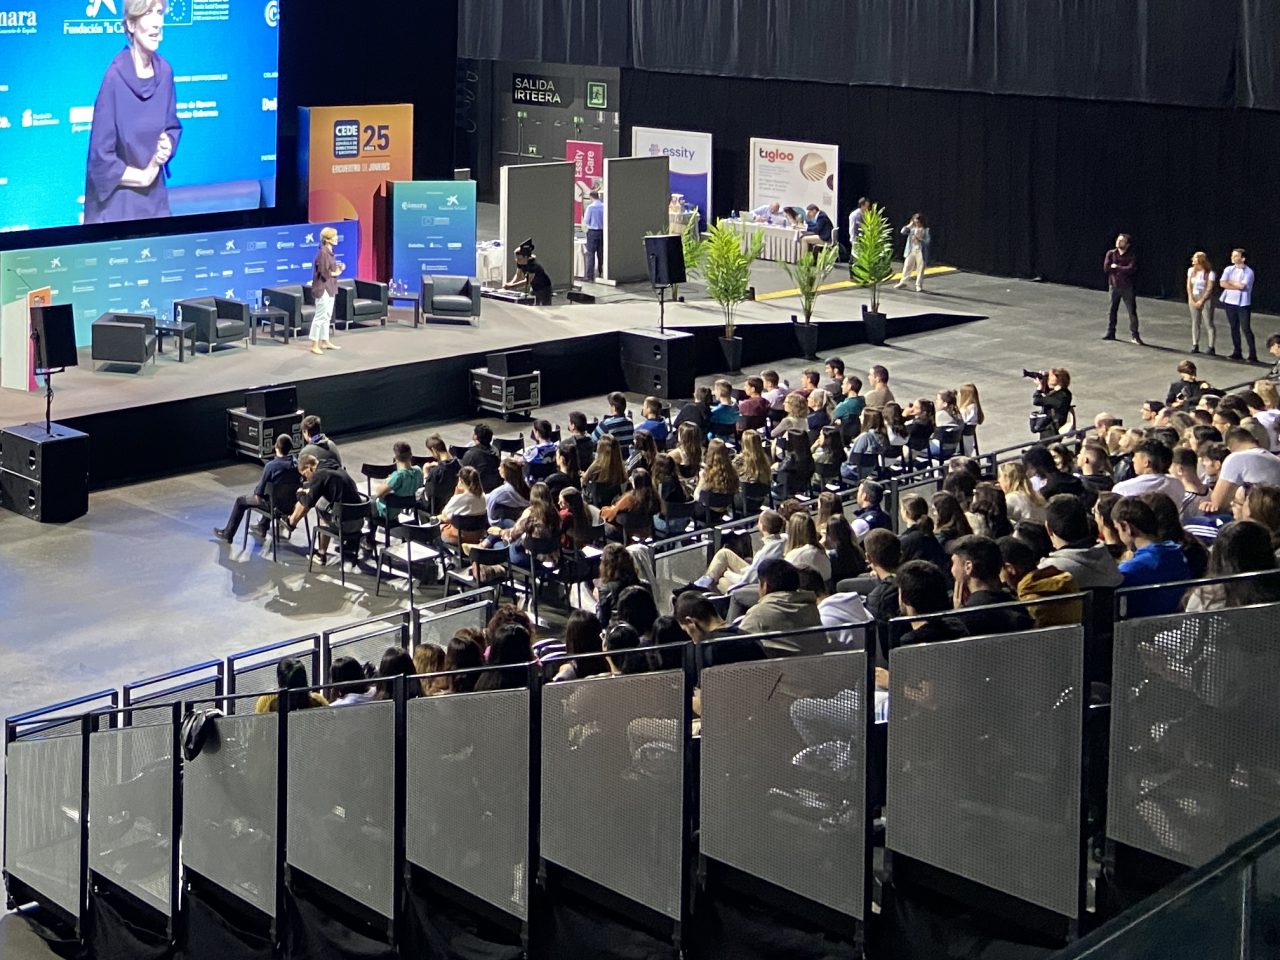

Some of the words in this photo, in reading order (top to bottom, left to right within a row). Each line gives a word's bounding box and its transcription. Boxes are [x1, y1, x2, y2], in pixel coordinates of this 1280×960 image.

[515, 77, 555, 91] SALIDA
[514, 89, 561, 104] IRTEERA
[335, 125, 359, 137] CEDE
[363, 124, 390, 151] 25
[662, 146, 695, 161] essity
[759, 147, 794, 163] tigloo
[574, 149, 585, 178] Essity
[585, 150, 595, 175] Care
